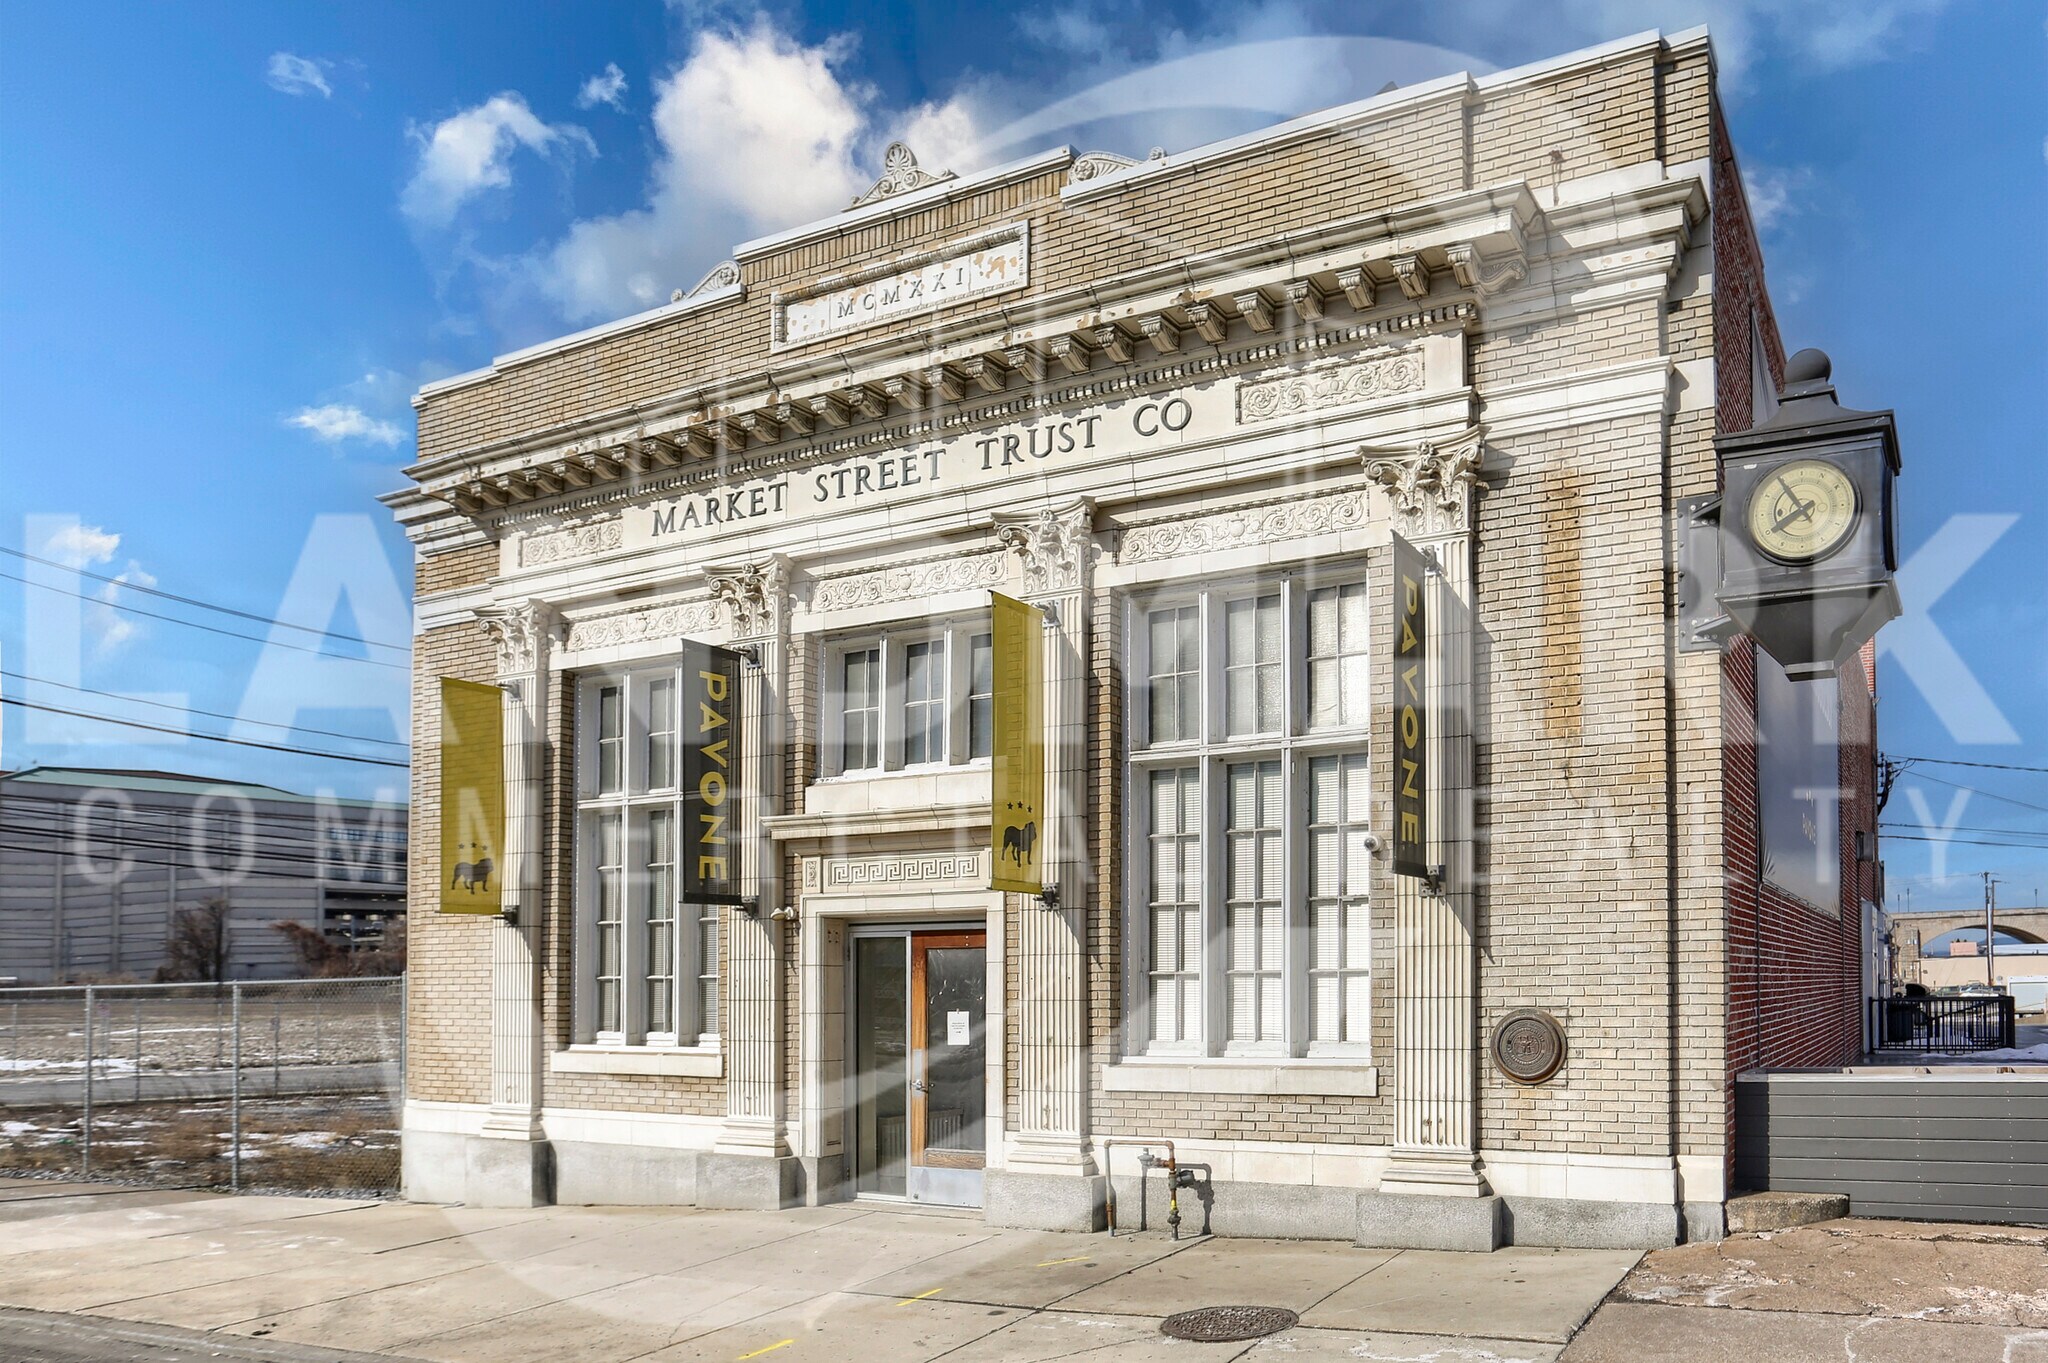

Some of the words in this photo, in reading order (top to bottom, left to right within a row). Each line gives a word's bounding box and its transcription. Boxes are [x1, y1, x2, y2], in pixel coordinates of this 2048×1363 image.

[837, 267, 964, 319] MCMXXI
[651, 482, 788, 537] MARKET
[813, 448, 946, 502] STREET
[975, 414, 1103, 470] TRUST
[1131, 397, 1193, 438] CO
[699, 670, 729, 881] PAVONE
[1400, 573, 1419, 846] PAVONE
